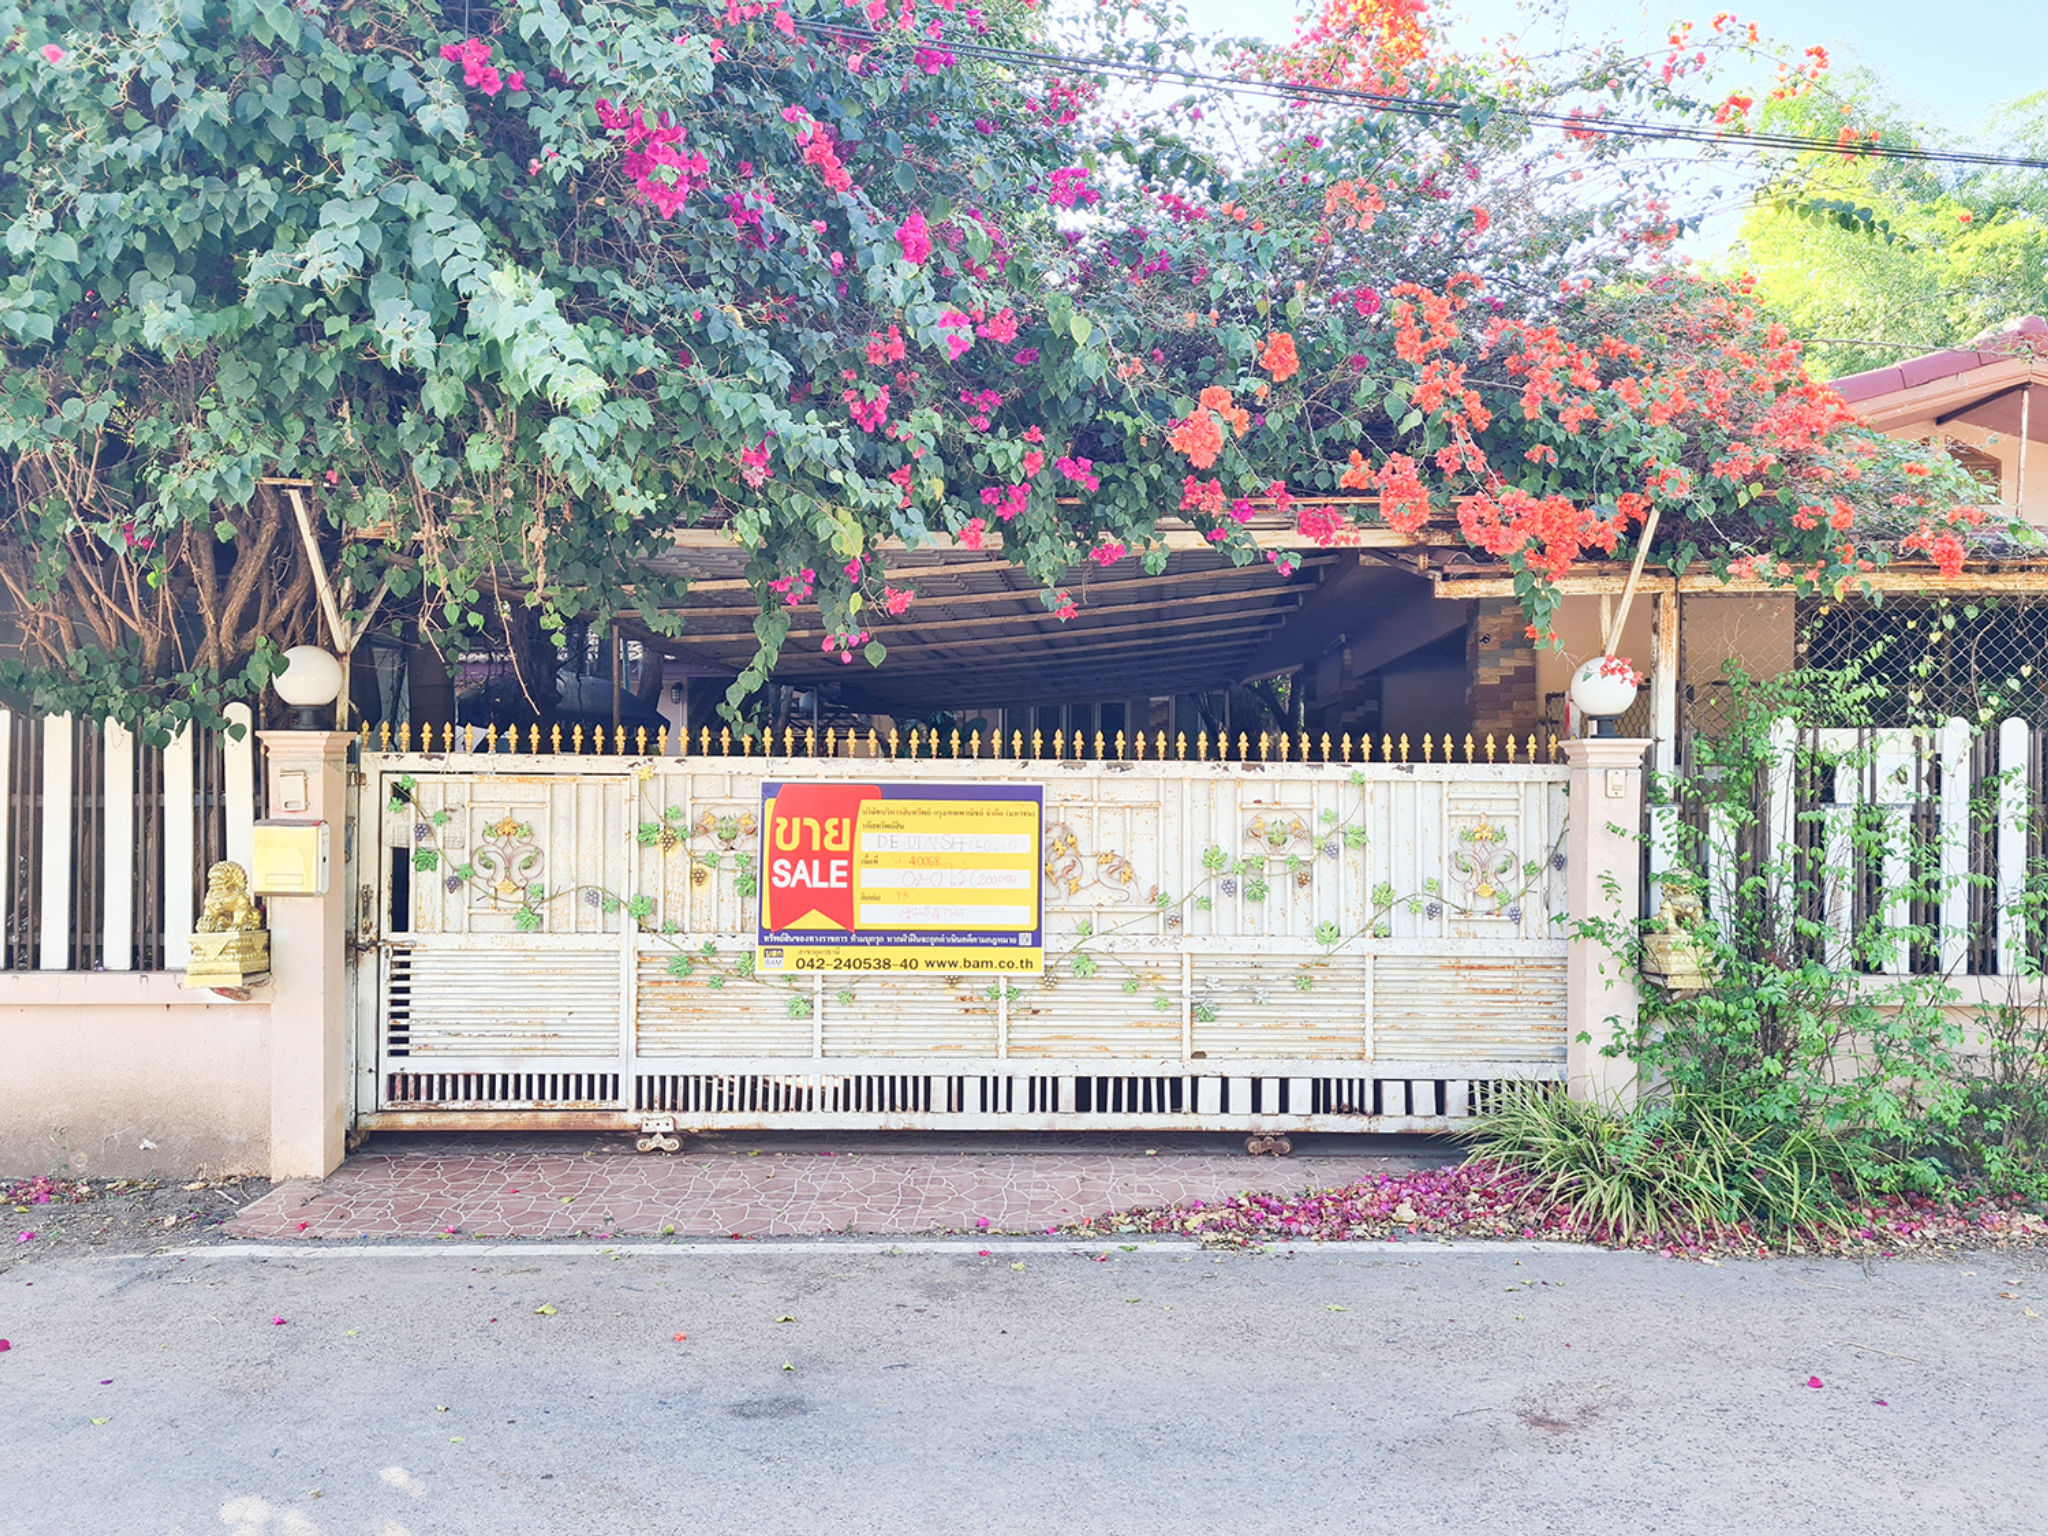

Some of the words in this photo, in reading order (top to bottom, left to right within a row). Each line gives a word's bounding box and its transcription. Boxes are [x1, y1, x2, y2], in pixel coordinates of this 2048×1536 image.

[775, 817, 851, 852] ขาย
[771, 859, 849, 889] SALE
[796, 957, 919, 970] 042-240538-40
[924, 957, 1034, 970] www.bam.co.th
